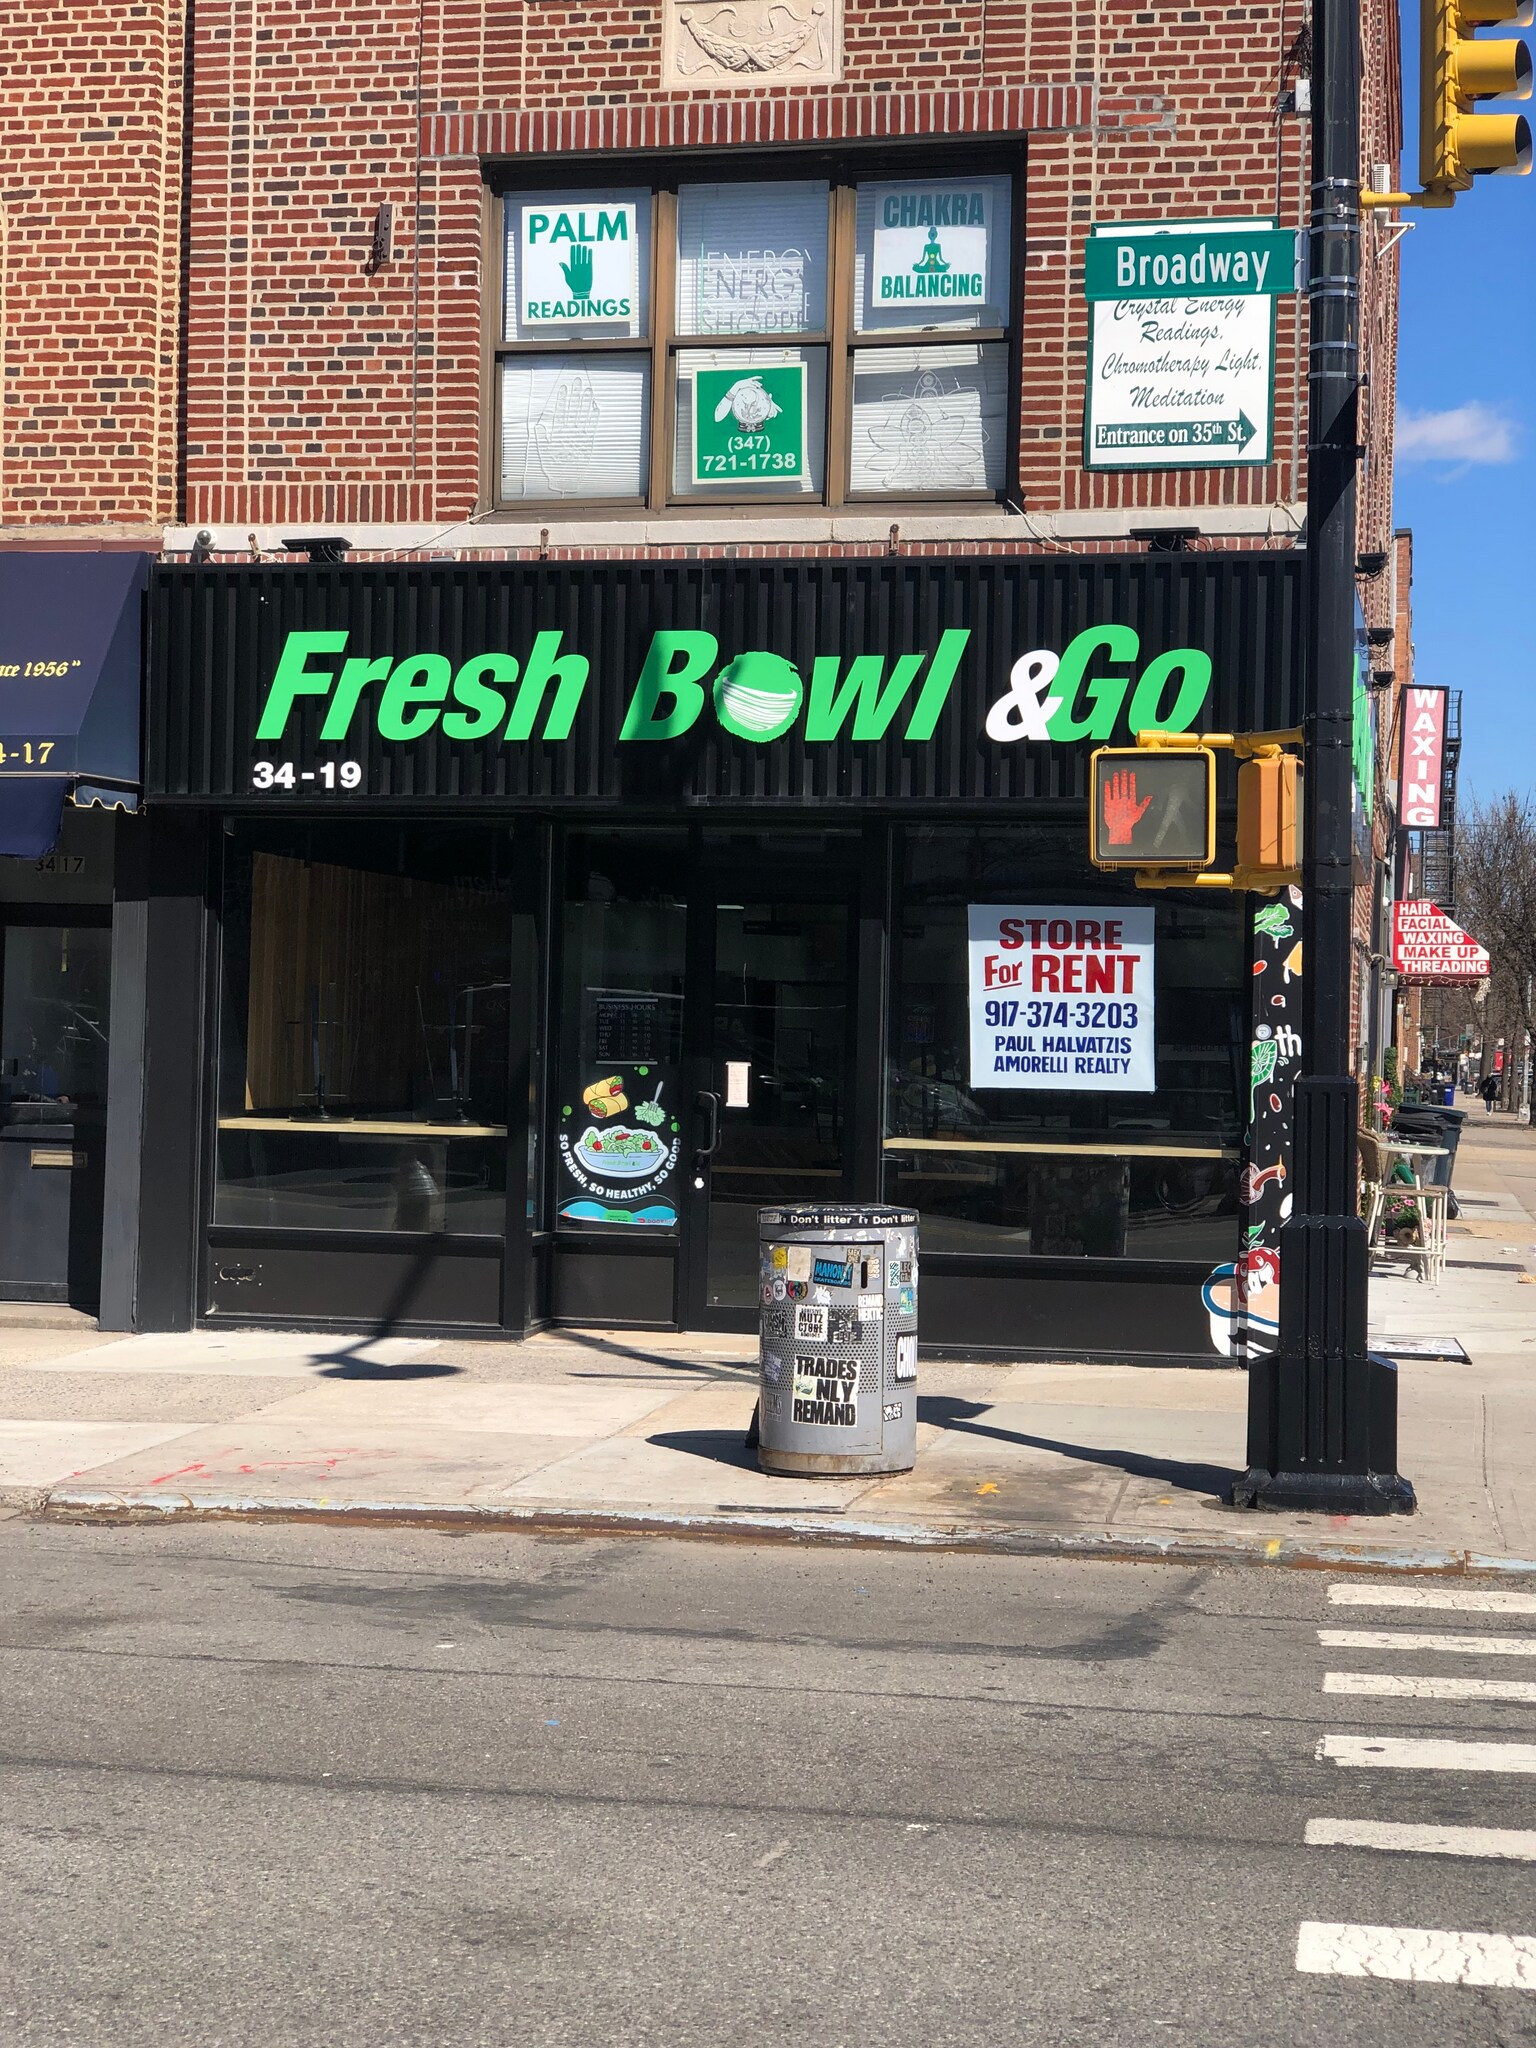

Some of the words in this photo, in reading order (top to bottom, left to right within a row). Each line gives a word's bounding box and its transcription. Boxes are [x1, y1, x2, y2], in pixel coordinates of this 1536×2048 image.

[883, 192, 985, 228] CHAKRA
[528, 210, 629, 245] PALM
[1117, 242, 1270, 292] Broadway
[880, 273, 983, 300] BALANCING
[527, 298, 631, 319] READINGS
[1113, 298, 1177, 321] Crystal
[1184, 297, 1245, 319] Energy
[1101, 350, 1210, 380] Chromotherapy
[1129, 385, 1225, 408] Meditation
[727, 435, 771, 453] (347)
[1097, 425, 1165, 446] Entrance
[1168, 432, 1189, 443] on
[1192, 422, 1222, 443] 35th
[1227, 421, 1247, 441] St.
[702, 453, 797, 472] 721-1738
[255, 630, 590, 741] Fresh
[618, 628, 972, 744] Bowl
[1406, 688, 1440, 827] WAXING
[251, 760, 363, 789] 34-19
[1399, 902, 1432, 916] HAIR
[999, 918, 1123, 951] STORE
[1401, 918, 1451, 930] FACIAL
[1402, 931, 1465, 945] WAXING
[1403, 946, 1452, 958] MAKE
[1457, 946, 1479, 958] UP
[984, 955, 1023, 987] For
[1031, 954, 1141, 994] RENT
[1401, 960, 1488, 973] THREADING
[984, 1000, 1138, 1029] 917-374-3203
[994, 1035, 1036, 1052] PAUL
[1042, 1036, 1132, 1054] HALVATZIS
[993, 1055, 1068, 1073] AMORELLI
[1074, 1057, 1131, 1074] REALTY
[560, 1133, 570, 1150] SO
[588, 1182, 604, 1196] SO
[605, 1181, 657, 1199] HEALTHY,
[654, 1169, 669, 1185] SO
[665, 1137, 681, 1170] GOOD
[790, 1215, 820, 1224] Don't
[823, 1215, 852, 1224] litter
[872, 1215, 899, 1225] Don't
[901, 1214, 916, 1223] litter
[795, 1355, 858, 1381] TRADES
[816, 1378, 855, 1403] NLY
[793, 1398, 856, 1426] REMAND
